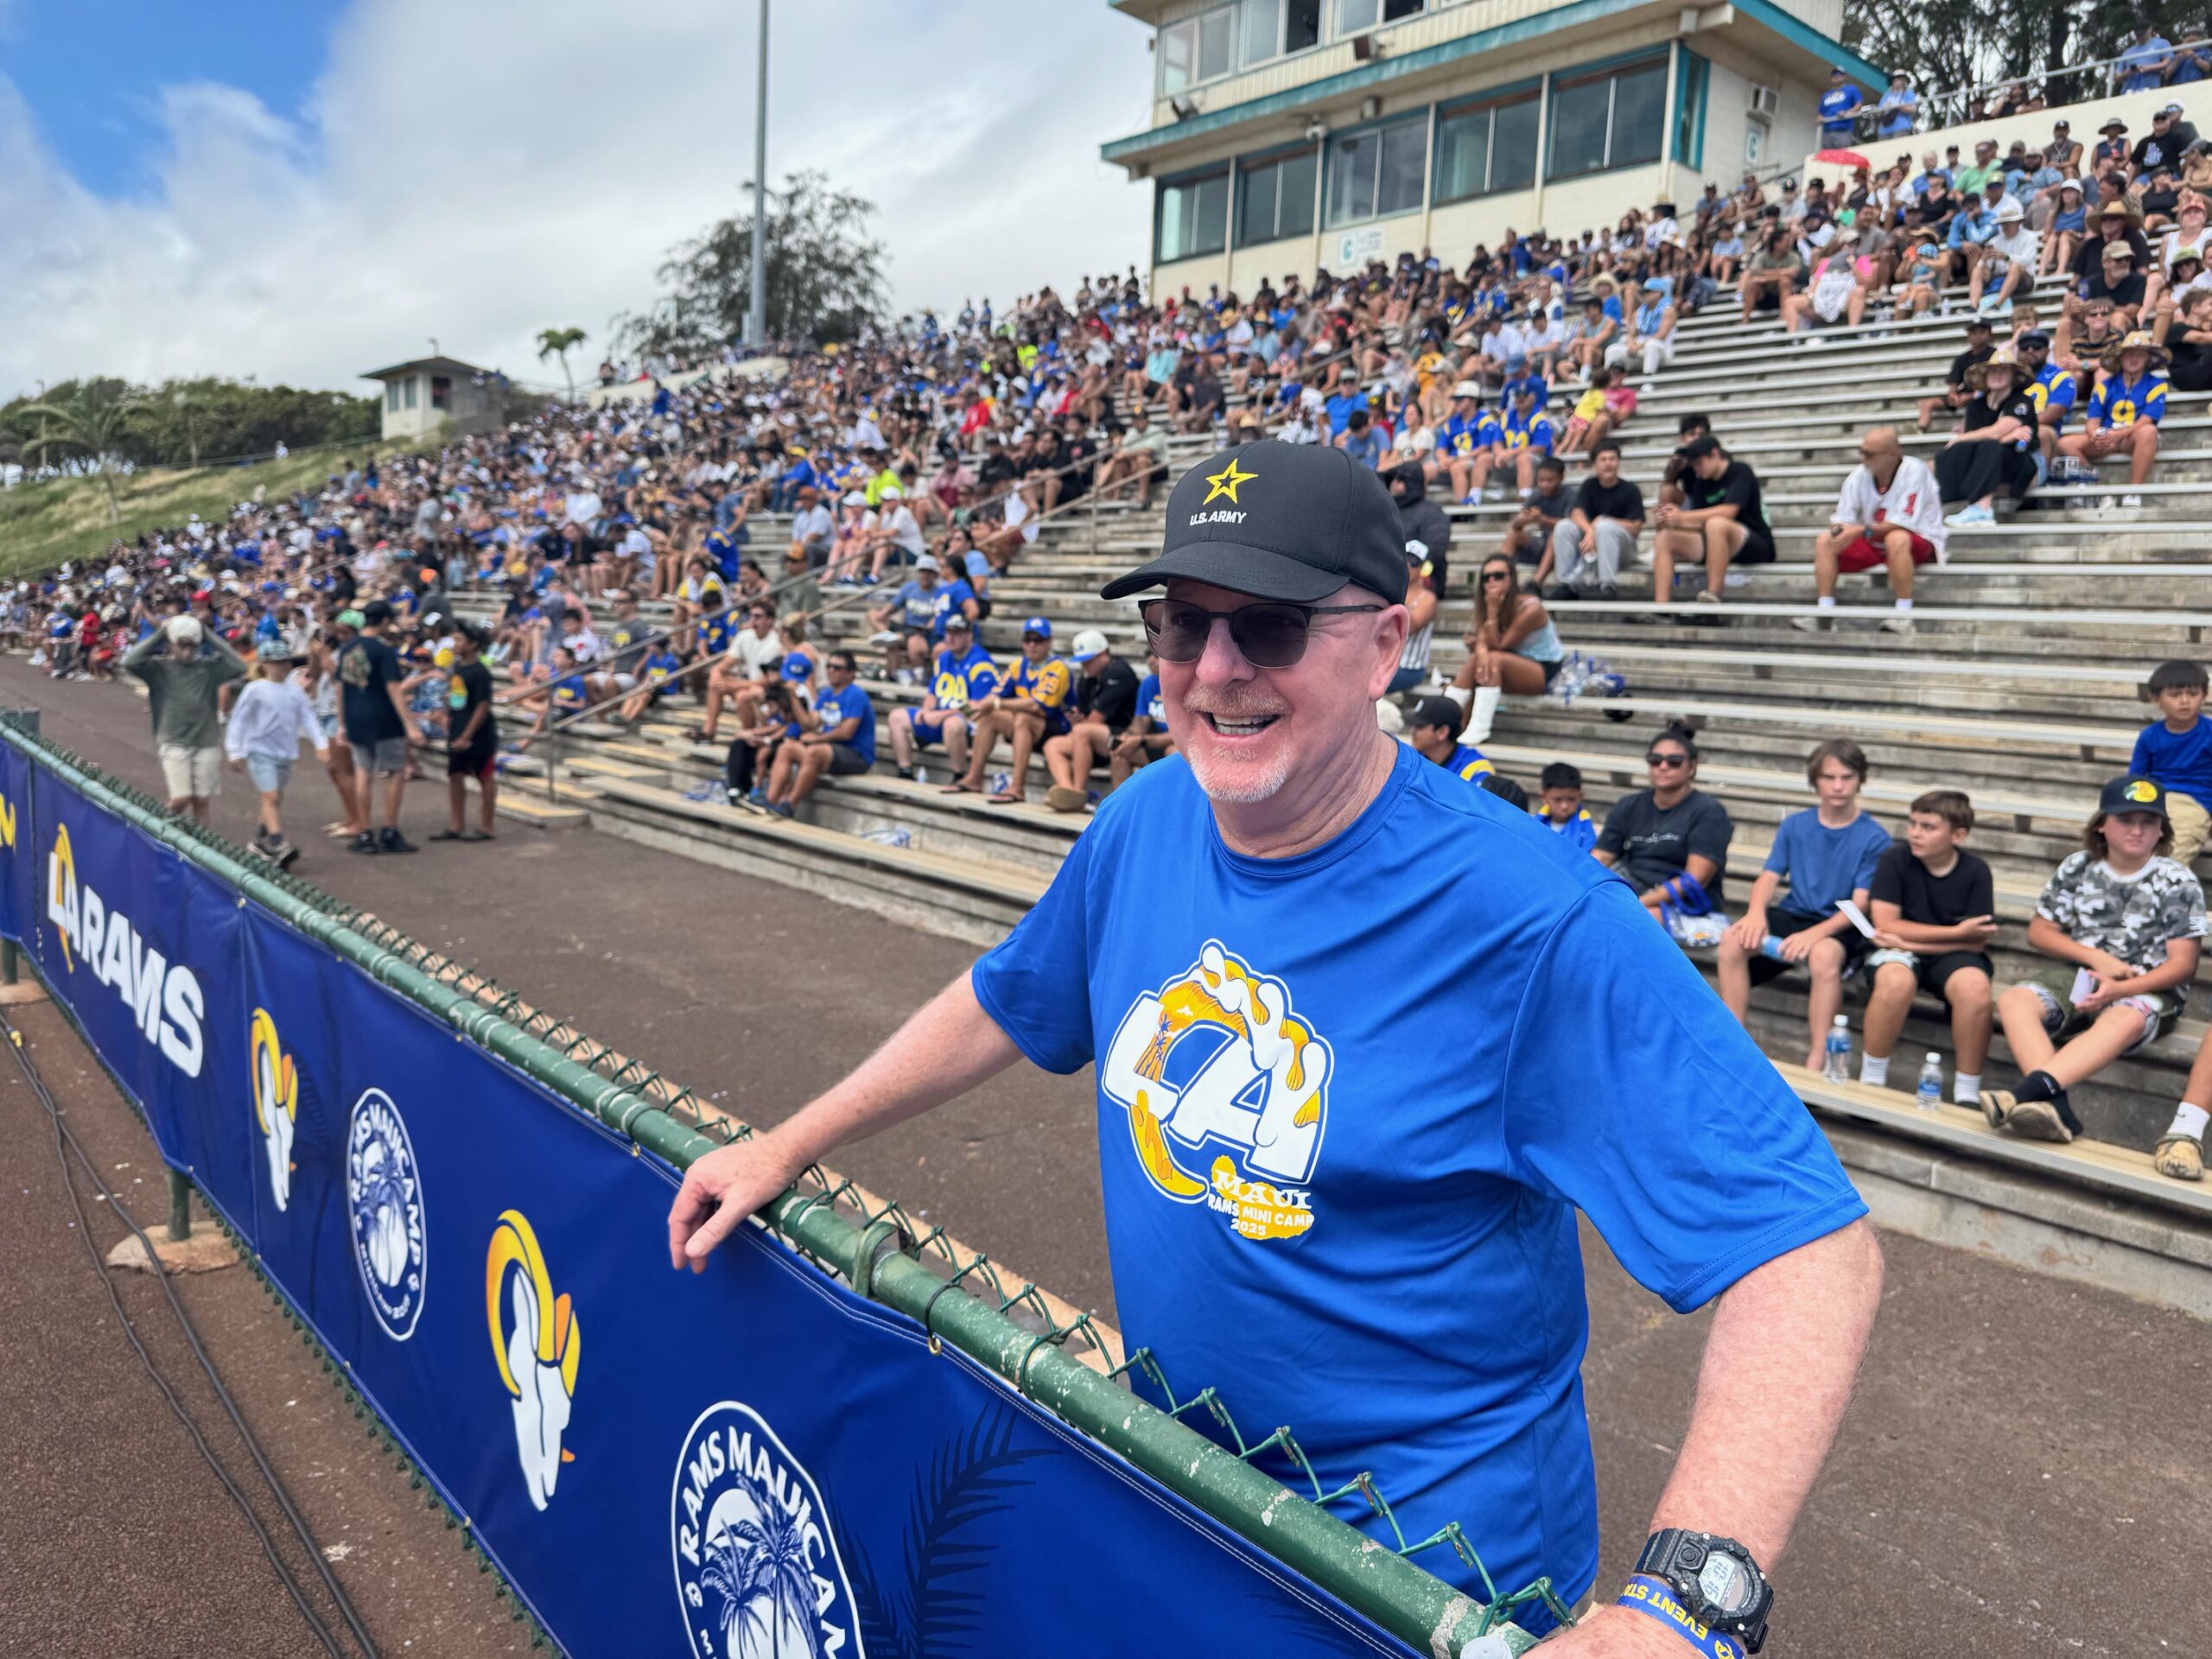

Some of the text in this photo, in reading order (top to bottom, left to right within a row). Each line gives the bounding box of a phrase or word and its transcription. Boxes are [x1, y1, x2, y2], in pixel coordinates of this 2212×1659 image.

[82, 884, 204, 1079] RAMS
[1207, 1192, 1314, 1228] RAMS MINI CAMP
[1211, 1168, 1313, 1210] MAUI
[1230, 1217, 1267, 1236] 2025
[680, 1430, 725, 1567] RAMS
[728, 1425, 812, 1529] MAUI
[1649, 1591, 1708, 1640] EVENT
